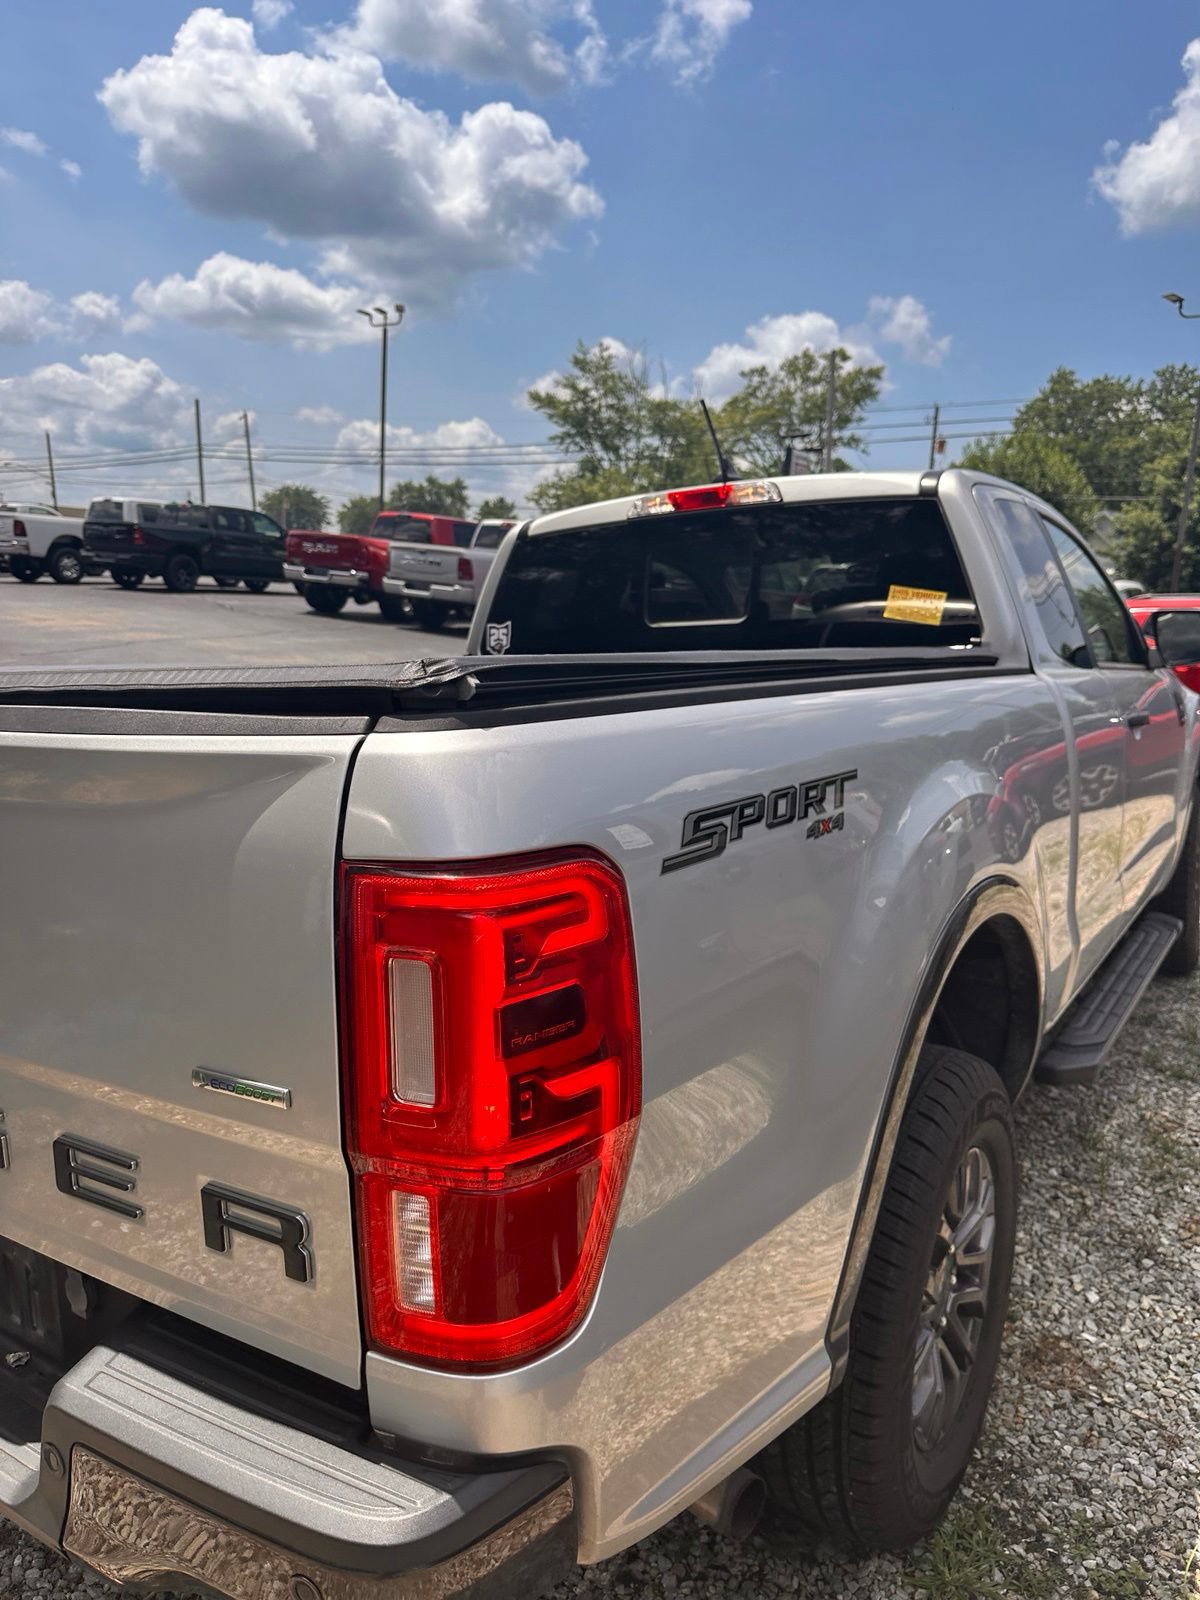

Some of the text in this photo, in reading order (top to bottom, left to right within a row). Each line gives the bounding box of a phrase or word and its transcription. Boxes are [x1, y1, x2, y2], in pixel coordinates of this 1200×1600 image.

[659, 768, 858, 876] SPORT
[511, 1020, 576, 1047] RANGER
[0, 1110, 313, 1283] ER
